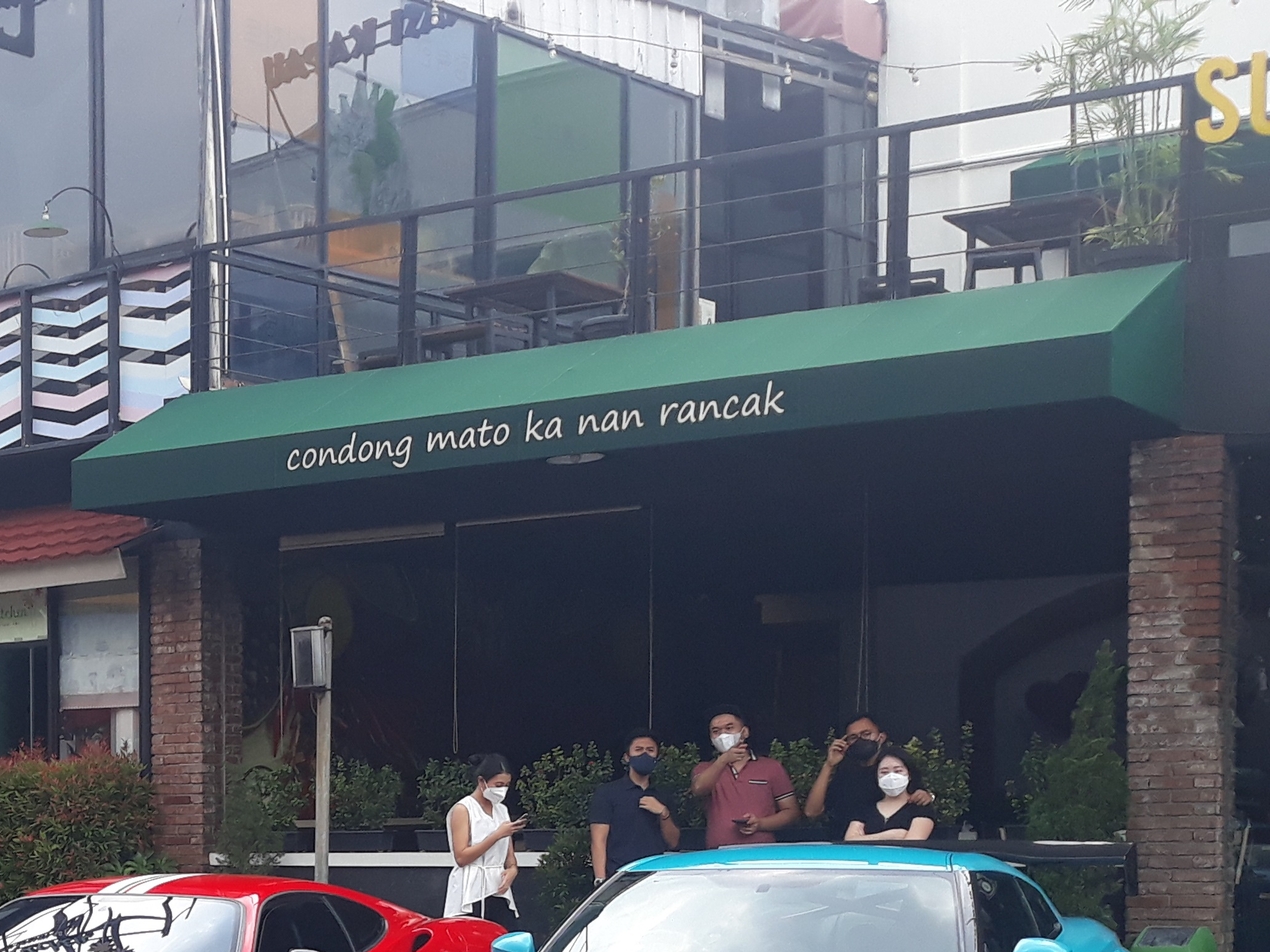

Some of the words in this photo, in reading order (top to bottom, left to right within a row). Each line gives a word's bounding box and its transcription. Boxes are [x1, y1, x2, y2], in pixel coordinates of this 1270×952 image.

[286, 432, 412, 470] condong
[426, 419, 510, 453] mato
[524, 410, 562, 443] ka
[577, 409, 644, 436] nan
[659, 380, 785, 427] rancak
